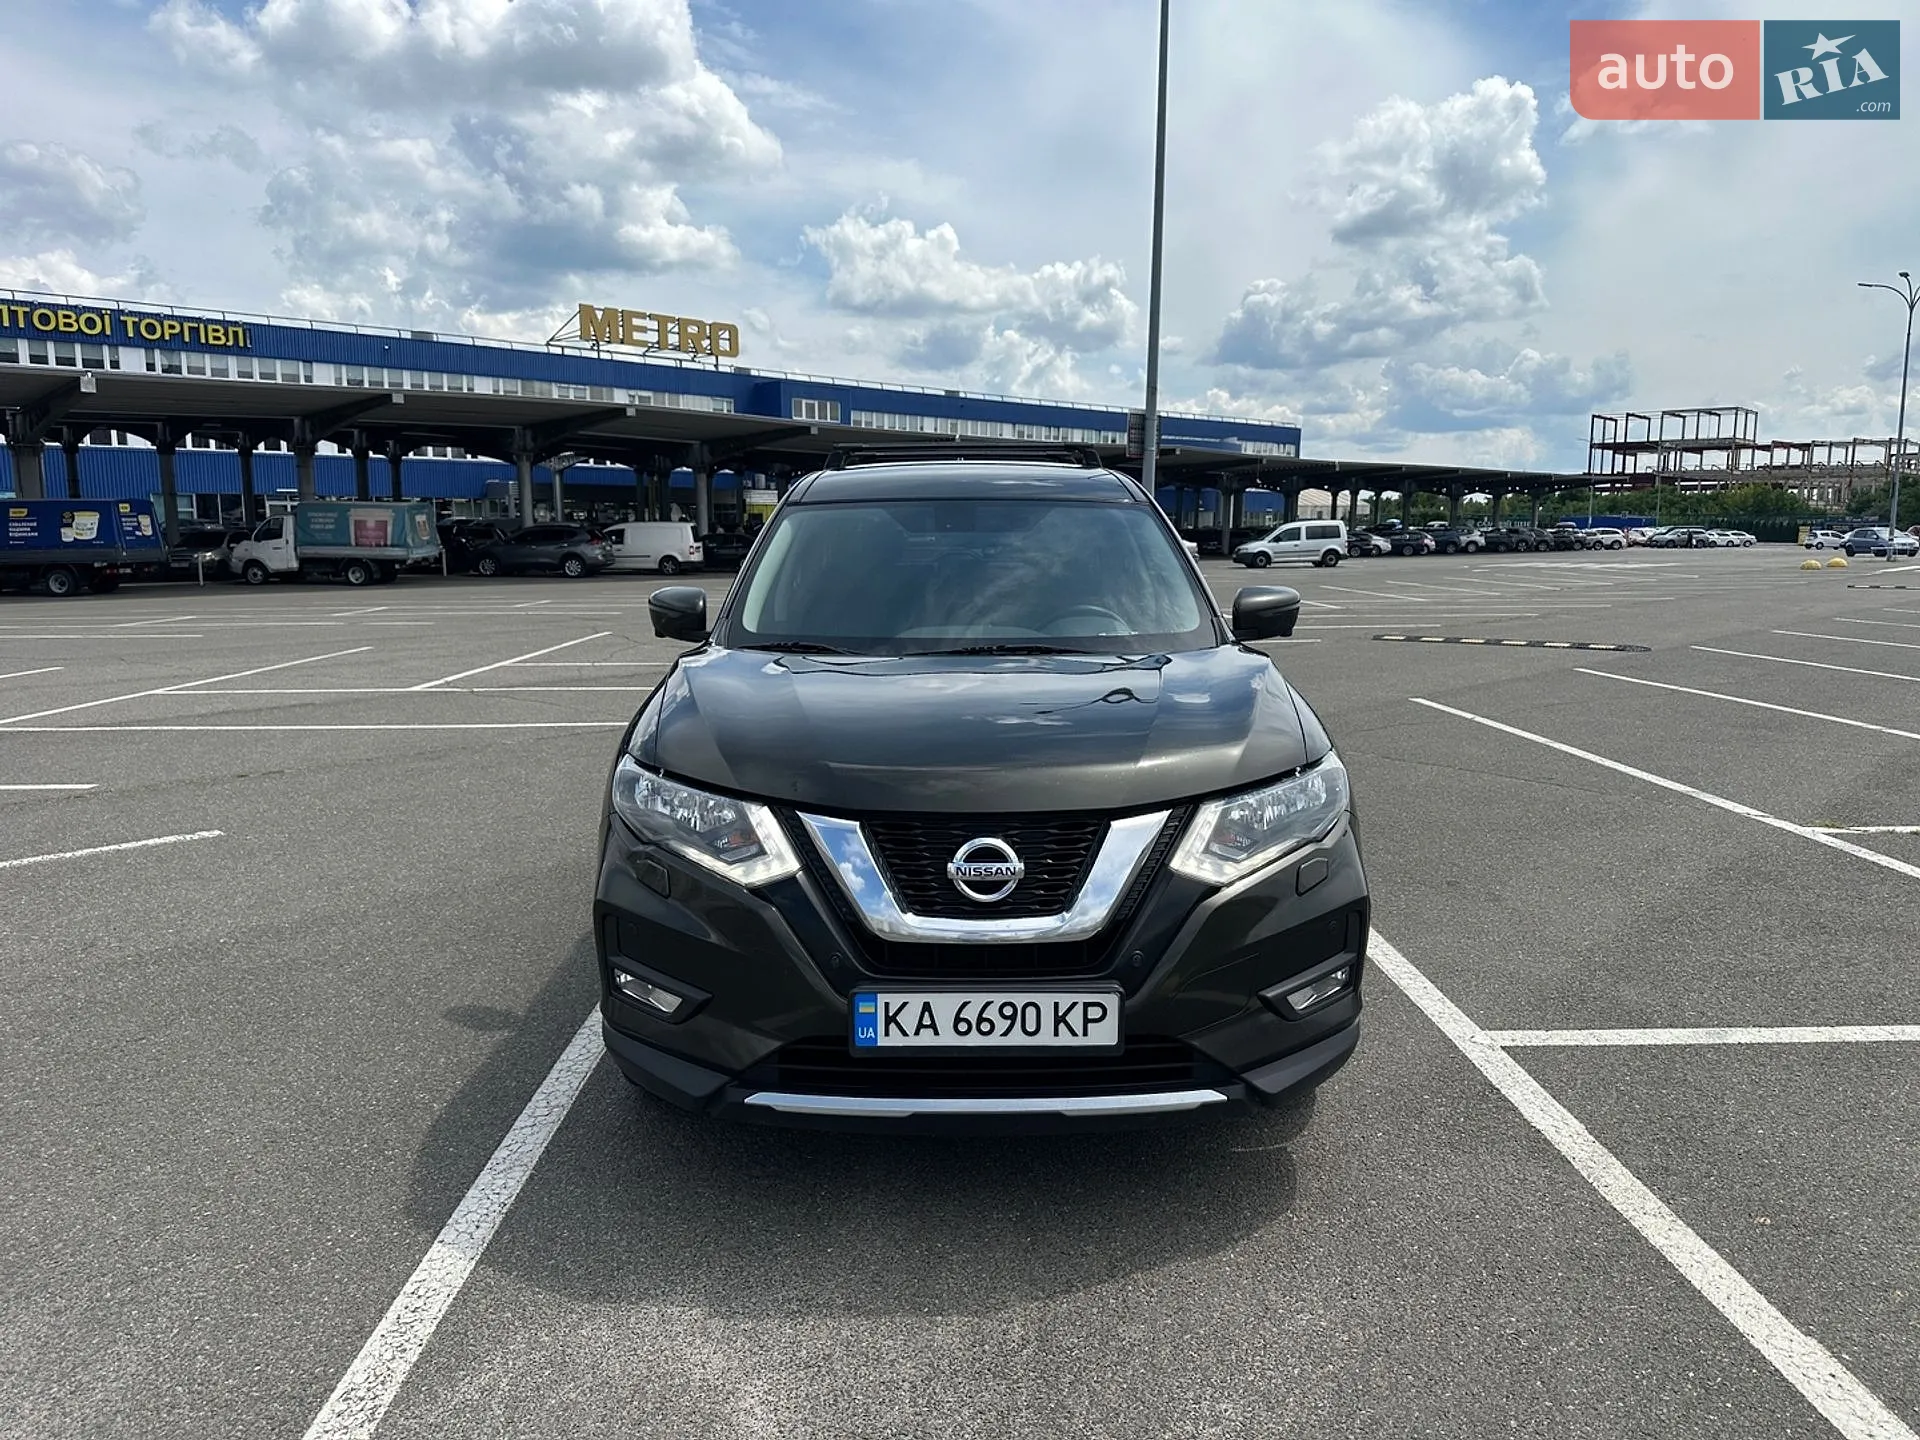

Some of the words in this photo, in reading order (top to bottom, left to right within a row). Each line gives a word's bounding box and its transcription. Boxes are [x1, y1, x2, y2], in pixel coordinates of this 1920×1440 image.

[579, 303, 739, 358] METRO
[956, 866, 1016, 876] NISSAN
[884, 1001, 940, 1037] KA
[953, 1001, 1042, 1037] 6690
[1053, 1001, 1108, 1037] KP
[858, 1027, 875, 1039] UA
